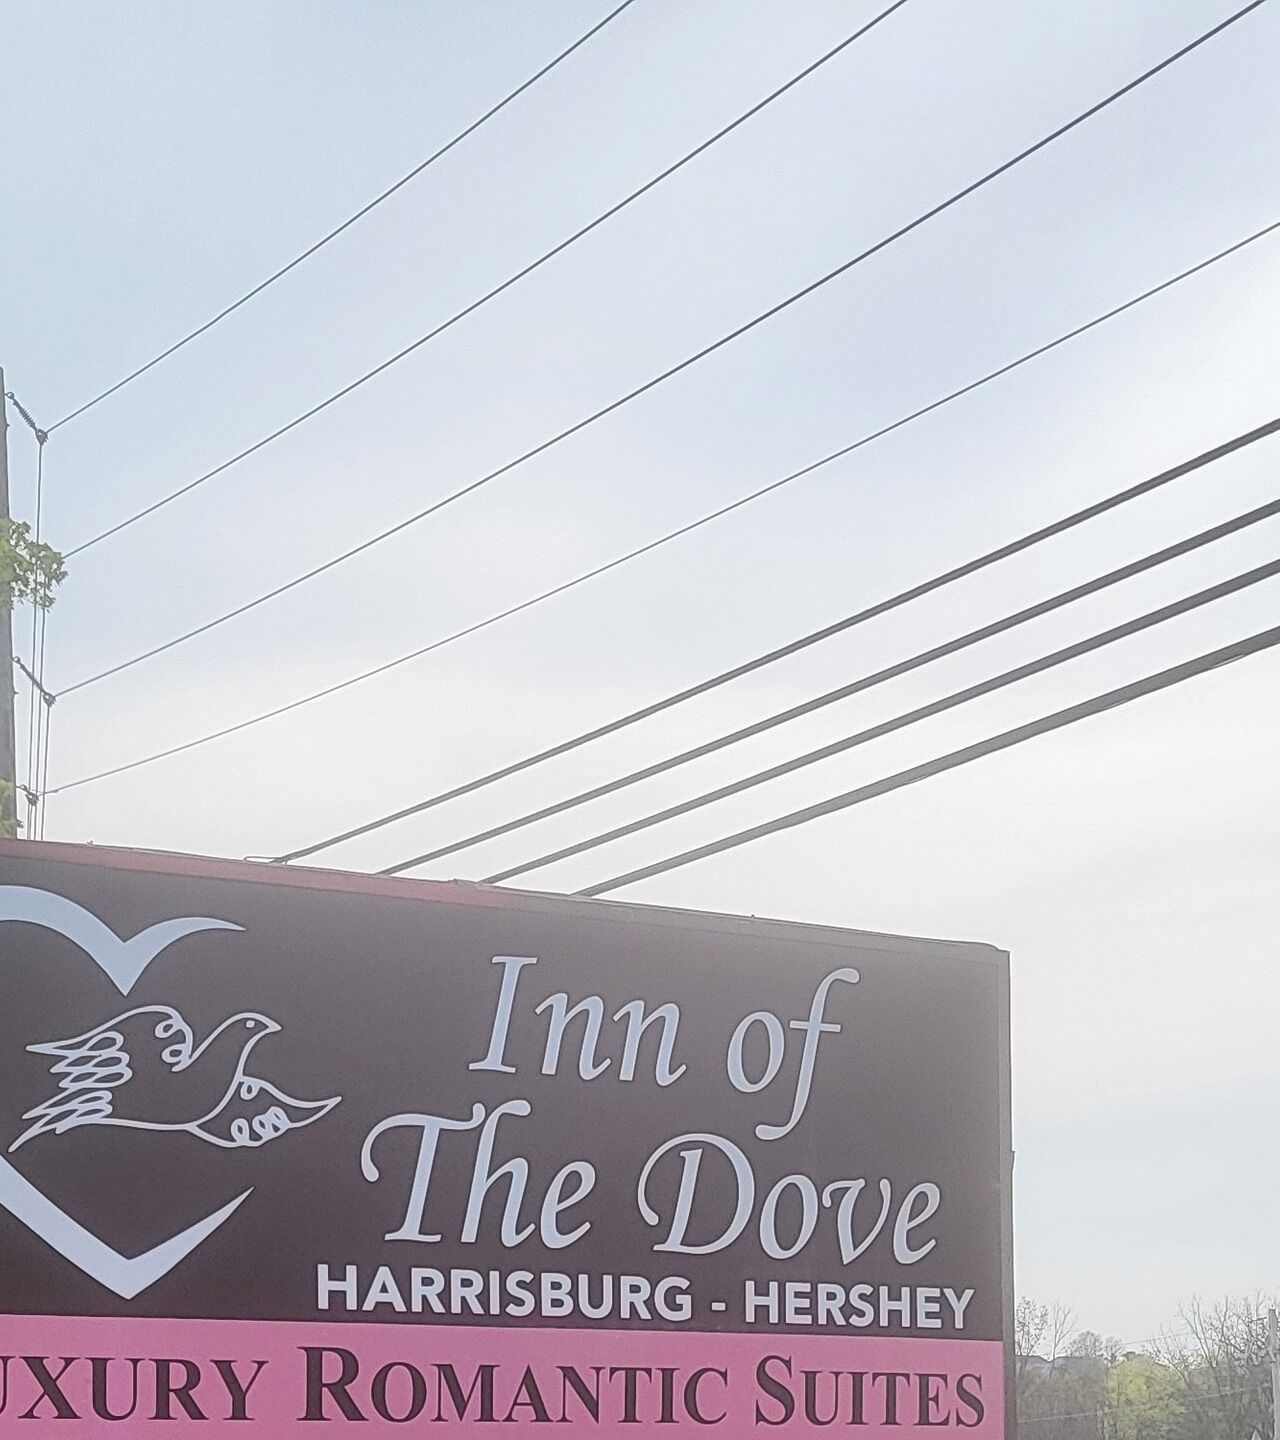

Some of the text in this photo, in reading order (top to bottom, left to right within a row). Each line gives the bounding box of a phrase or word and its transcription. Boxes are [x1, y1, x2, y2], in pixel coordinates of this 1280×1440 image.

[468, 955, 860, 1141] Inn of
[361, 1099, 941, 1265] The Dove
[317, 1263, 692, 1322] HARRISBURG
[745, 1280, 975, 1329] HERSHEY
[296, 1346, 728, 1425] ROMANTIC
[756, 1356, 986, 1428] SUITES
